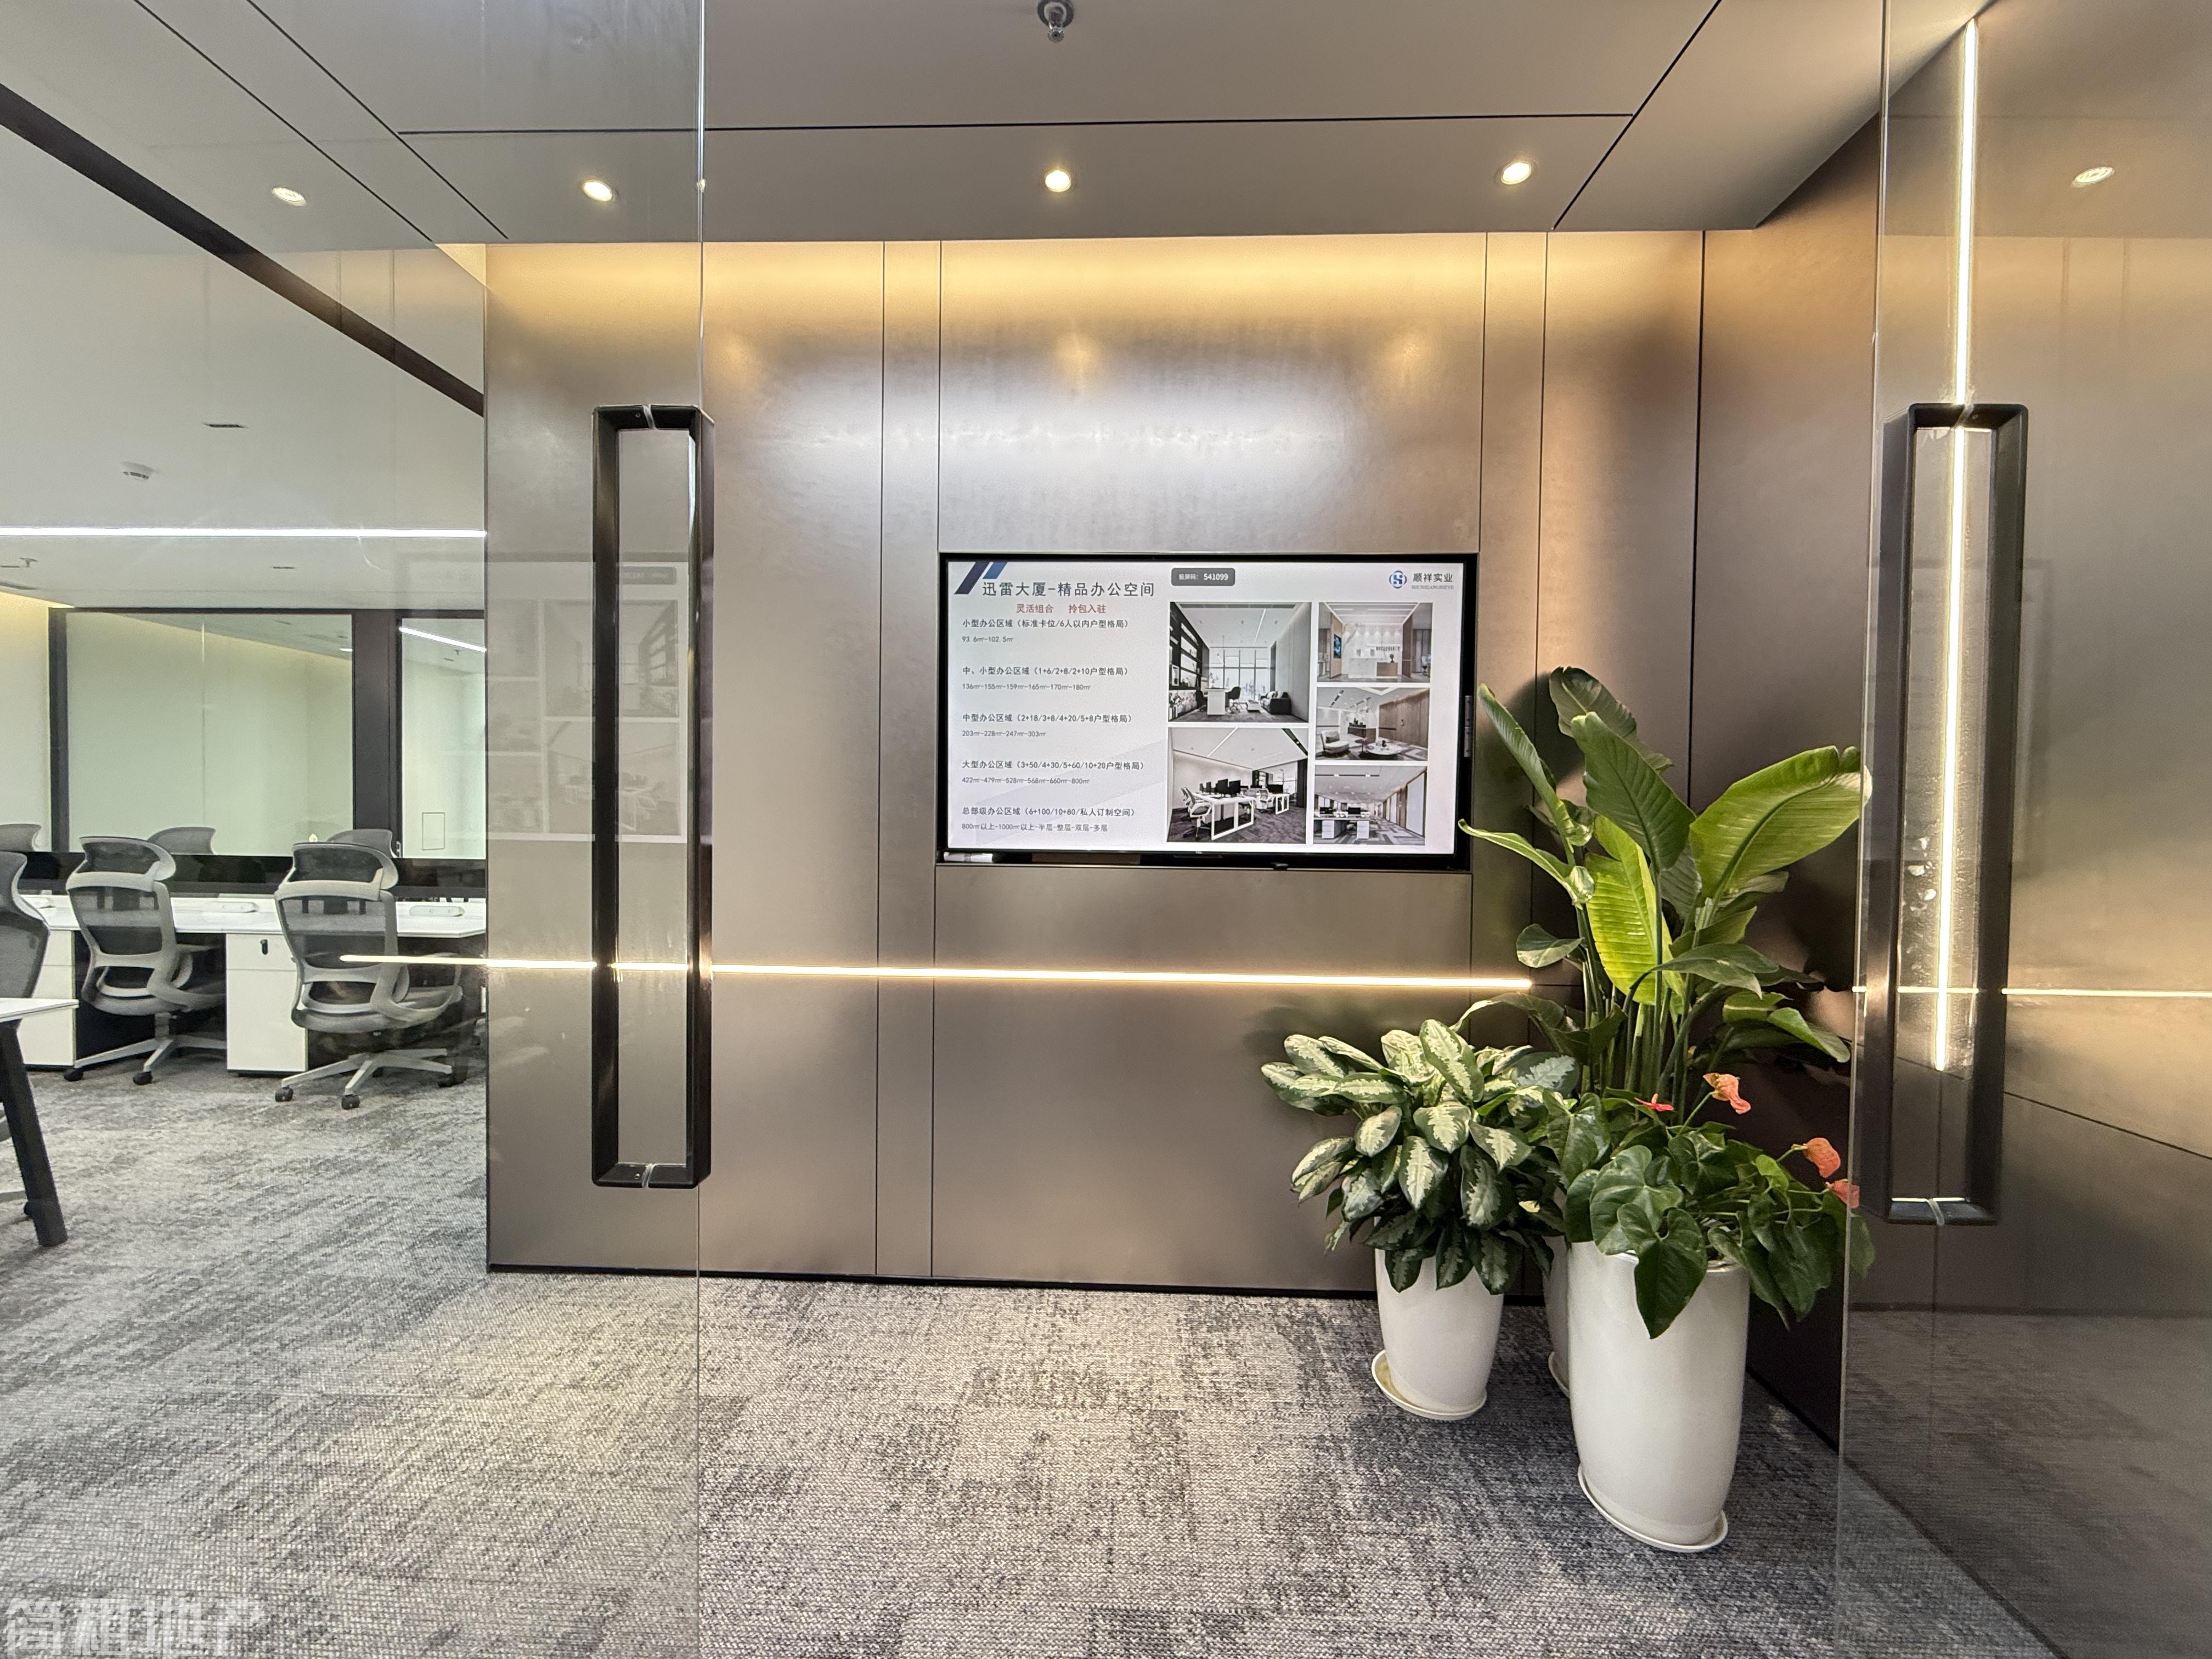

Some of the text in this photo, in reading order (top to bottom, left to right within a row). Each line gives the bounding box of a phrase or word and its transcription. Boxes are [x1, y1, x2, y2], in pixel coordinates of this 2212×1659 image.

[1413, 573, 1453, 582] 顺祥实业
[982, 582, 1154, 597] 迅雷大厦-精品办公空间
[1016, 604, 1107, 614] 灵活组合 拎包入驻
